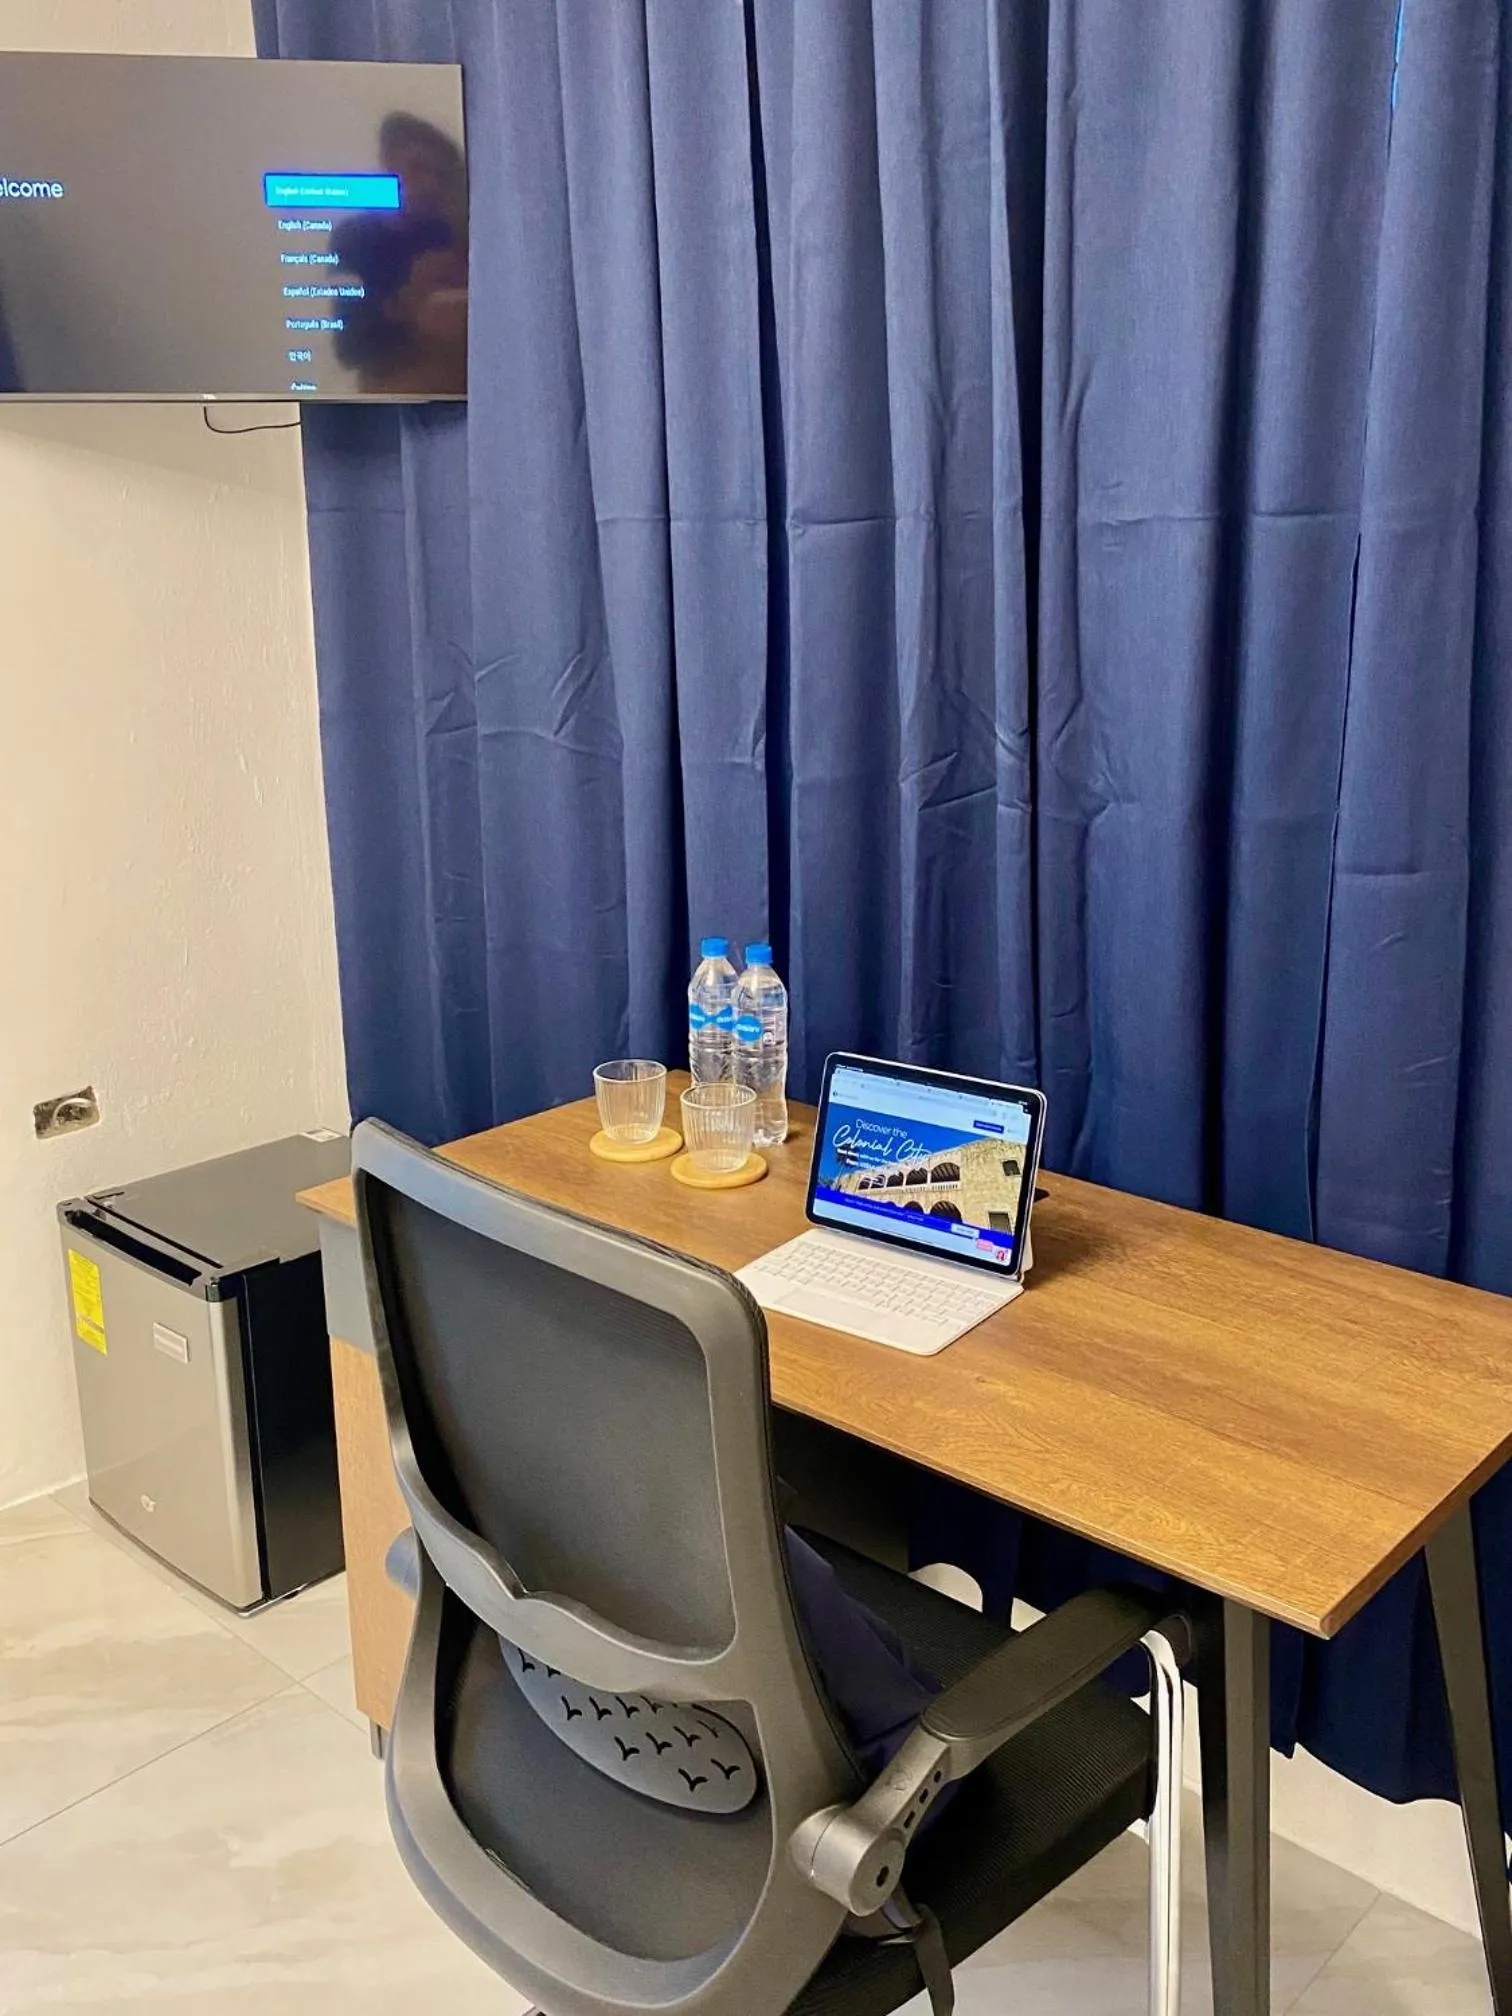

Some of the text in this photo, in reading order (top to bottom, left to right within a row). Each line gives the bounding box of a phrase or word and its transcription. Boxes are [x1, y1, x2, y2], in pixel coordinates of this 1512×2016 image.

[0, 177, 64, 198] lcome
[278, 220, 333, 231] English (Canada)
[309, 253, 339, 266] (Canada)
[855, 1118, 908, 1139] Discover the
[832, 1124, 894, 1157] Colonial
